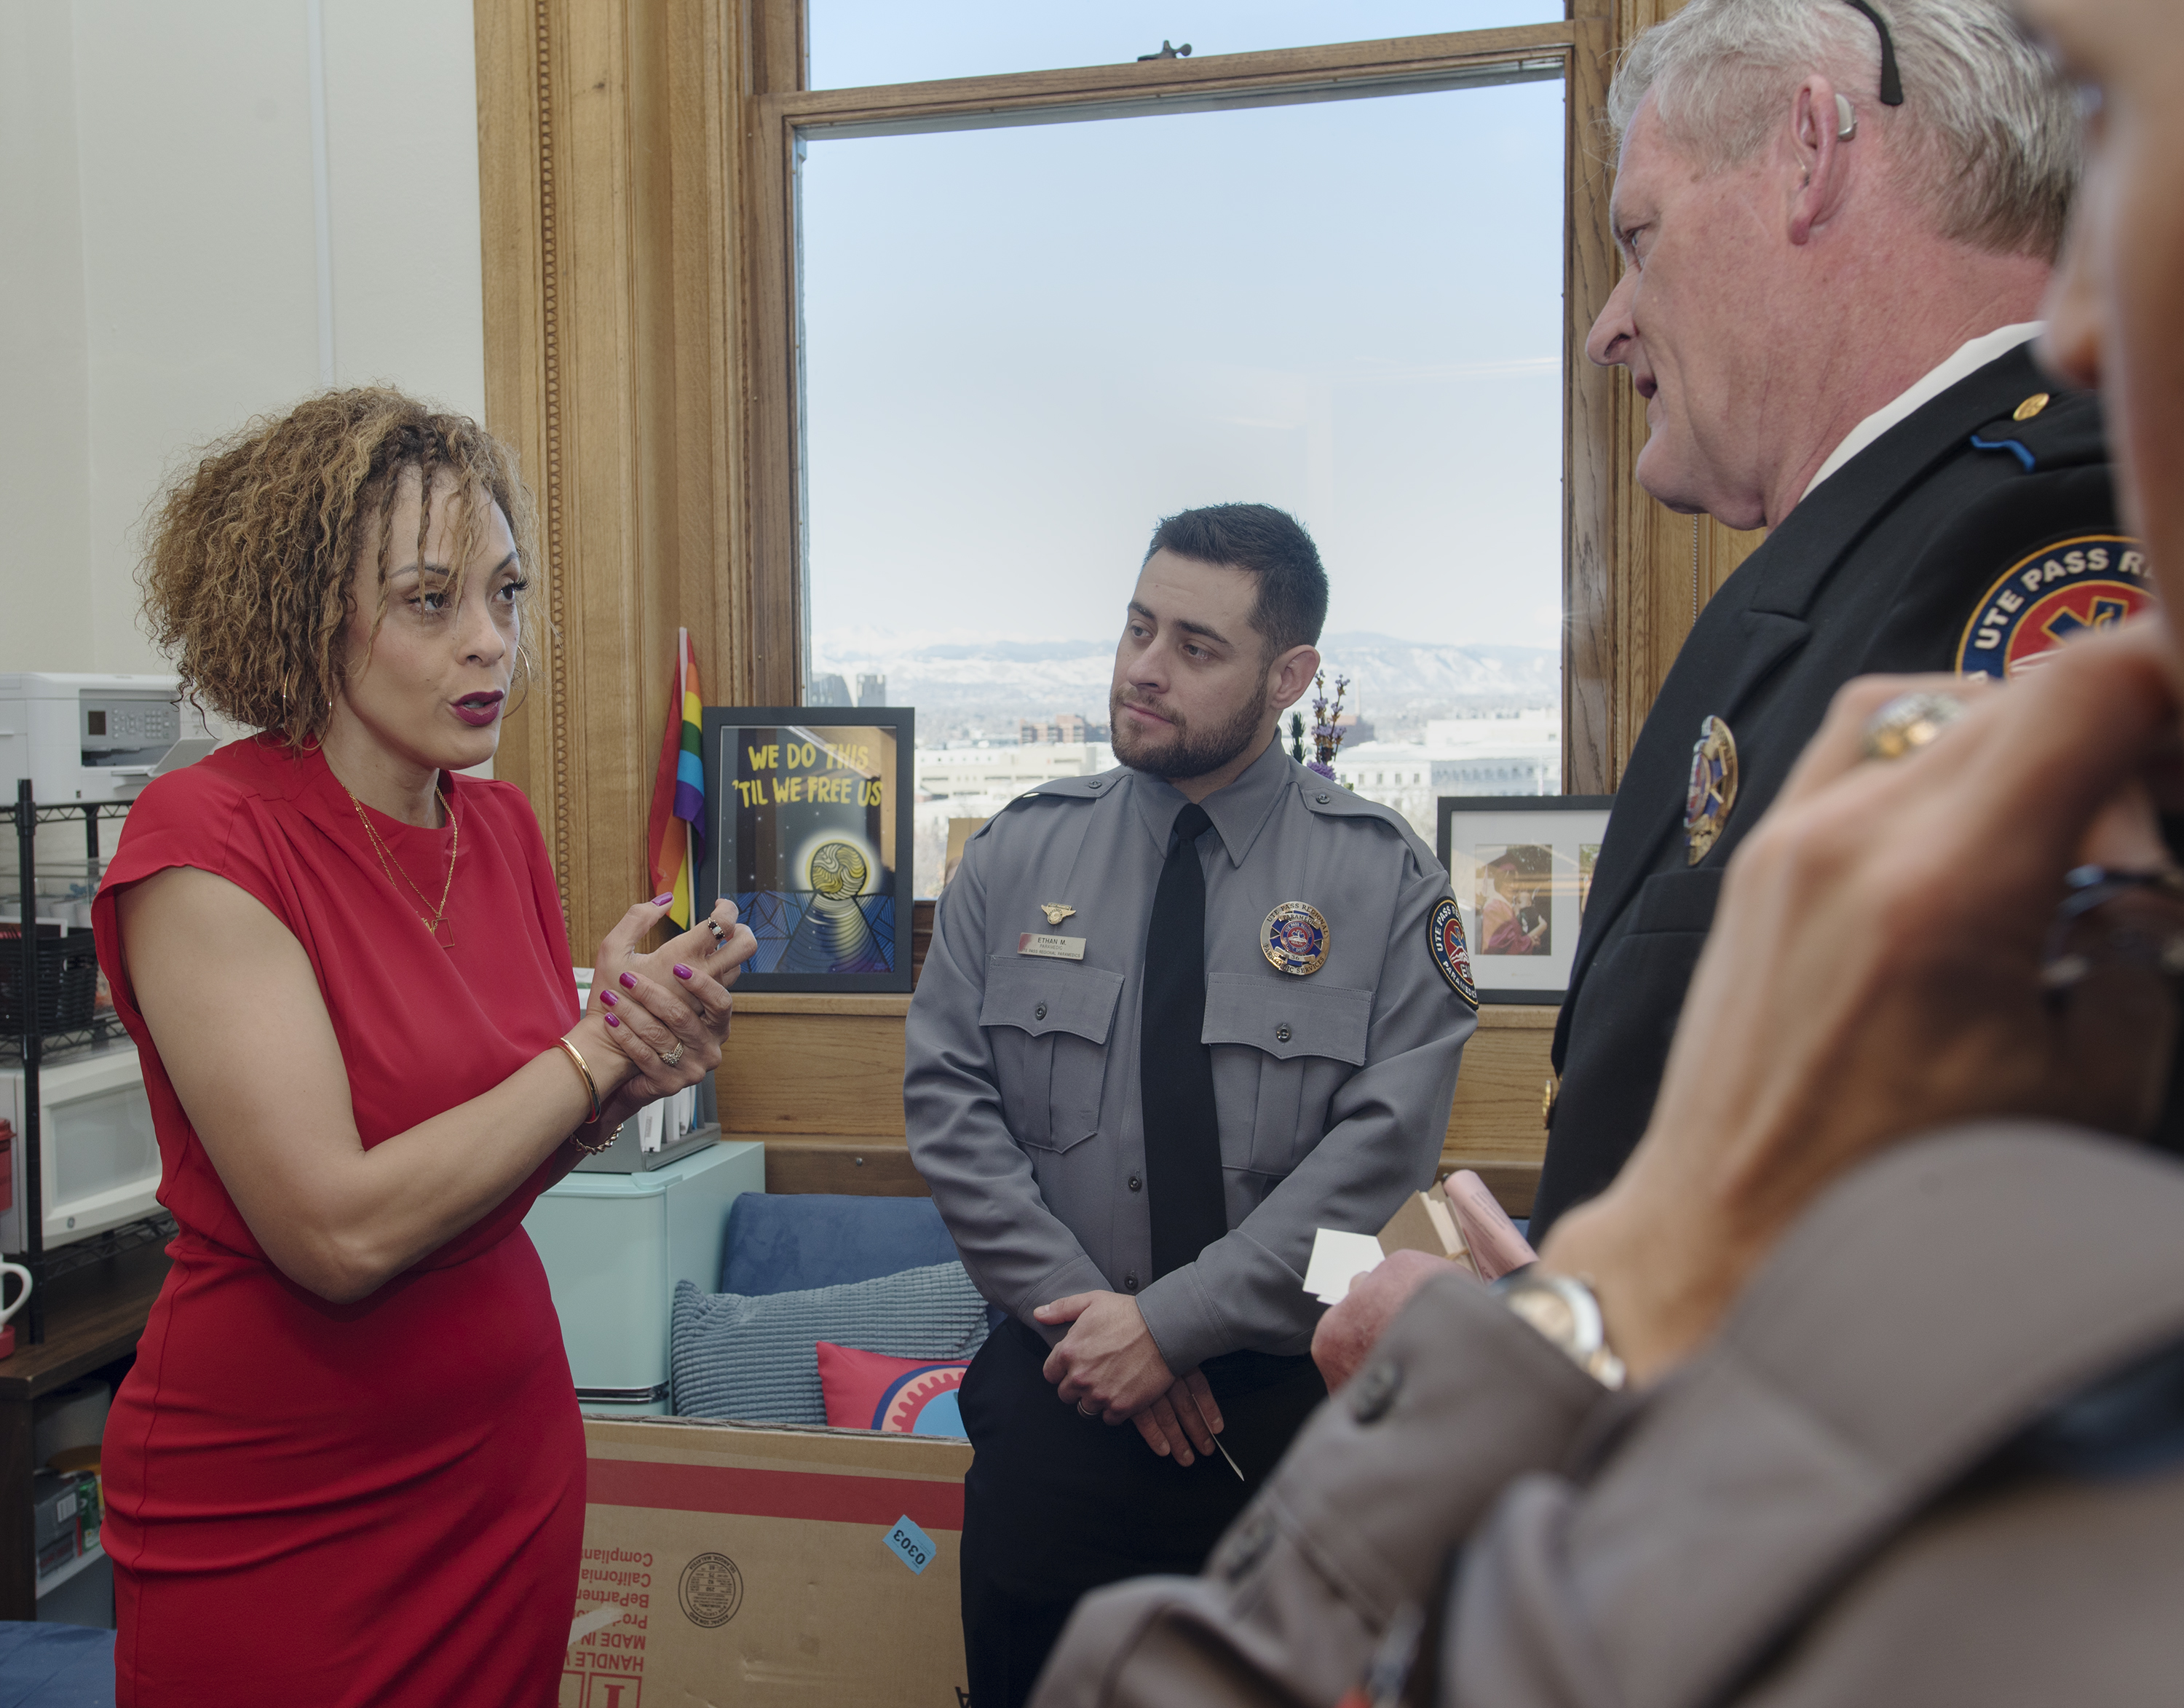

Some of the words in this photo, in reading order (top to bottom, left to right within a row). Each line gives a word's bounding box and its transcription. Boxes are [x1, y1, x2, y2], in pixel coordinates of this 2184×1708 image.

[1974, 589, 2025, 650] UTE
[2020, 547, 2109, 592] PASS
[748, 743, 779, 772] WE
[786, 741, 816, 770] DO
[823, 741, 869, 772] THIS
[772, 777, 802, 803] WE
[807, 775, 851, 804] FREE
[858, 780, 882, 807] US
[1267, 910, 1280, 922] UTE
[1281, 903, 1299, 912] PASS
[1302, 904, 1329, 936] REGIONAL
[1283, 914, 1317, 927] PARAMEDIC
[1436, 905, 1452, 927] PASS
[1434, 926, 1444, 952] UTE
[1296, 957, 1324, 973] SERVICES
[893, 1529, 926, 1565] 0303
[581, 1569, 652, 1589] California
[600, 1632, 646, 1650] MADE
[574, 1651, 644, 1672] HANDLE
